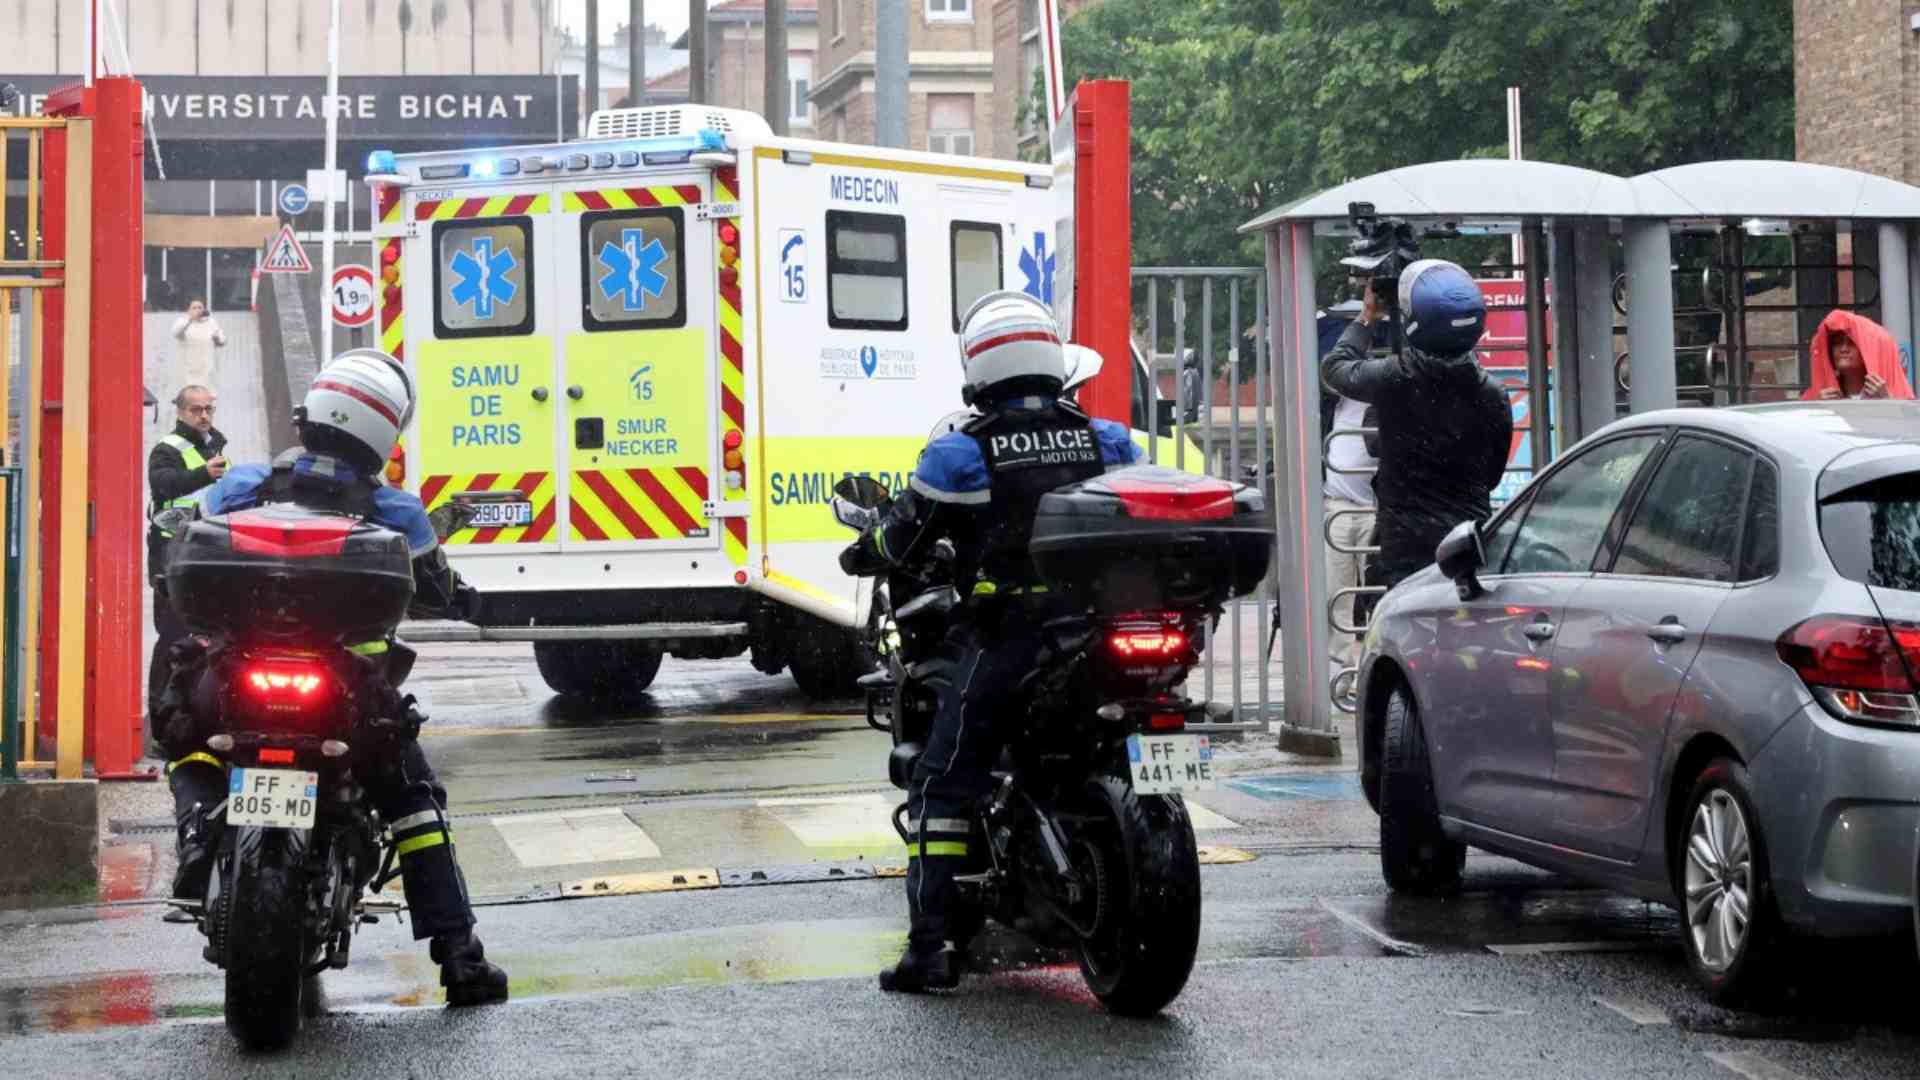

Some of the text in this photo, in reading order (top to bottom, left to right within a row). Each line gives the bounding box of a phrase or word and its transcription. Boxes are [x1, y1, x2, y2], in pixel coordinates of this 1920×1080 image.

[400, 94, 532, 119] BICHAT
[831, 175, 899, 204] MEDECIN
[784, 265, 805, 298] 15
[452, 365, 519, 388] SAMU
[634, 381, 652, 400] 15
[471, 395, 502, 416] DE
[452, 423, 521, 446] PARIS
[617, 418, 666, 434] SMUR
[607, 438, 678, 455] NECKER
[991, 429, 1092, 457] POLICE
[1040, 450, 1077, 465] MOTO
[771, 472, 834, 505] SAMU
[1151, 743, 1174, 760] FF
[1139, 762, 1212, 782] 441-ME
[255, 775, 280, 793] FF
[233, 796, 312, 817] 805-MD
